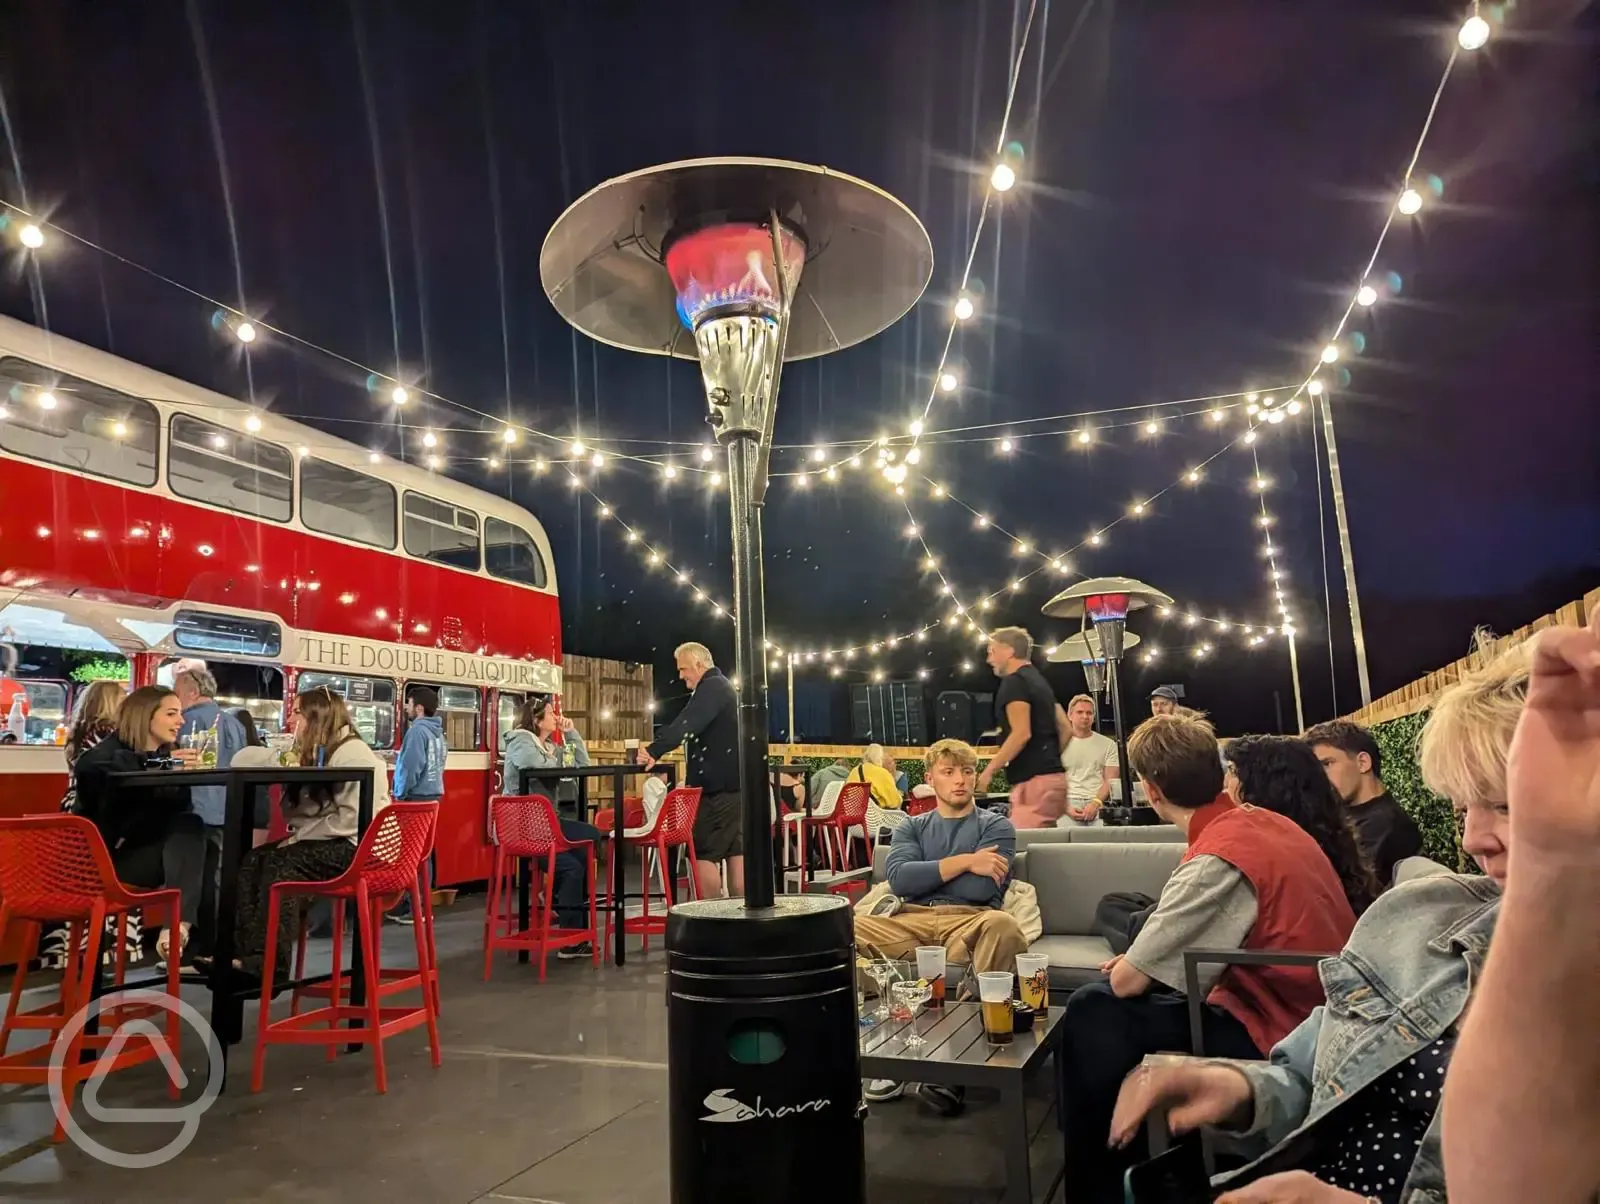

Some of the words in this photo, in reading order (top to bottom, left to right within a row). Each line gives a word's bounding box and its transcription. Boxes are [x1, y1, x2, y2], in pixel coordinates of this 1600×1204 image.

[300, 637, 351, 666] THE
[360, 645, 445, 676] DOUBLE
[452, 657, 535, 686] DAIQUIRI
[698, 1088, 831, 1123] Sahara
